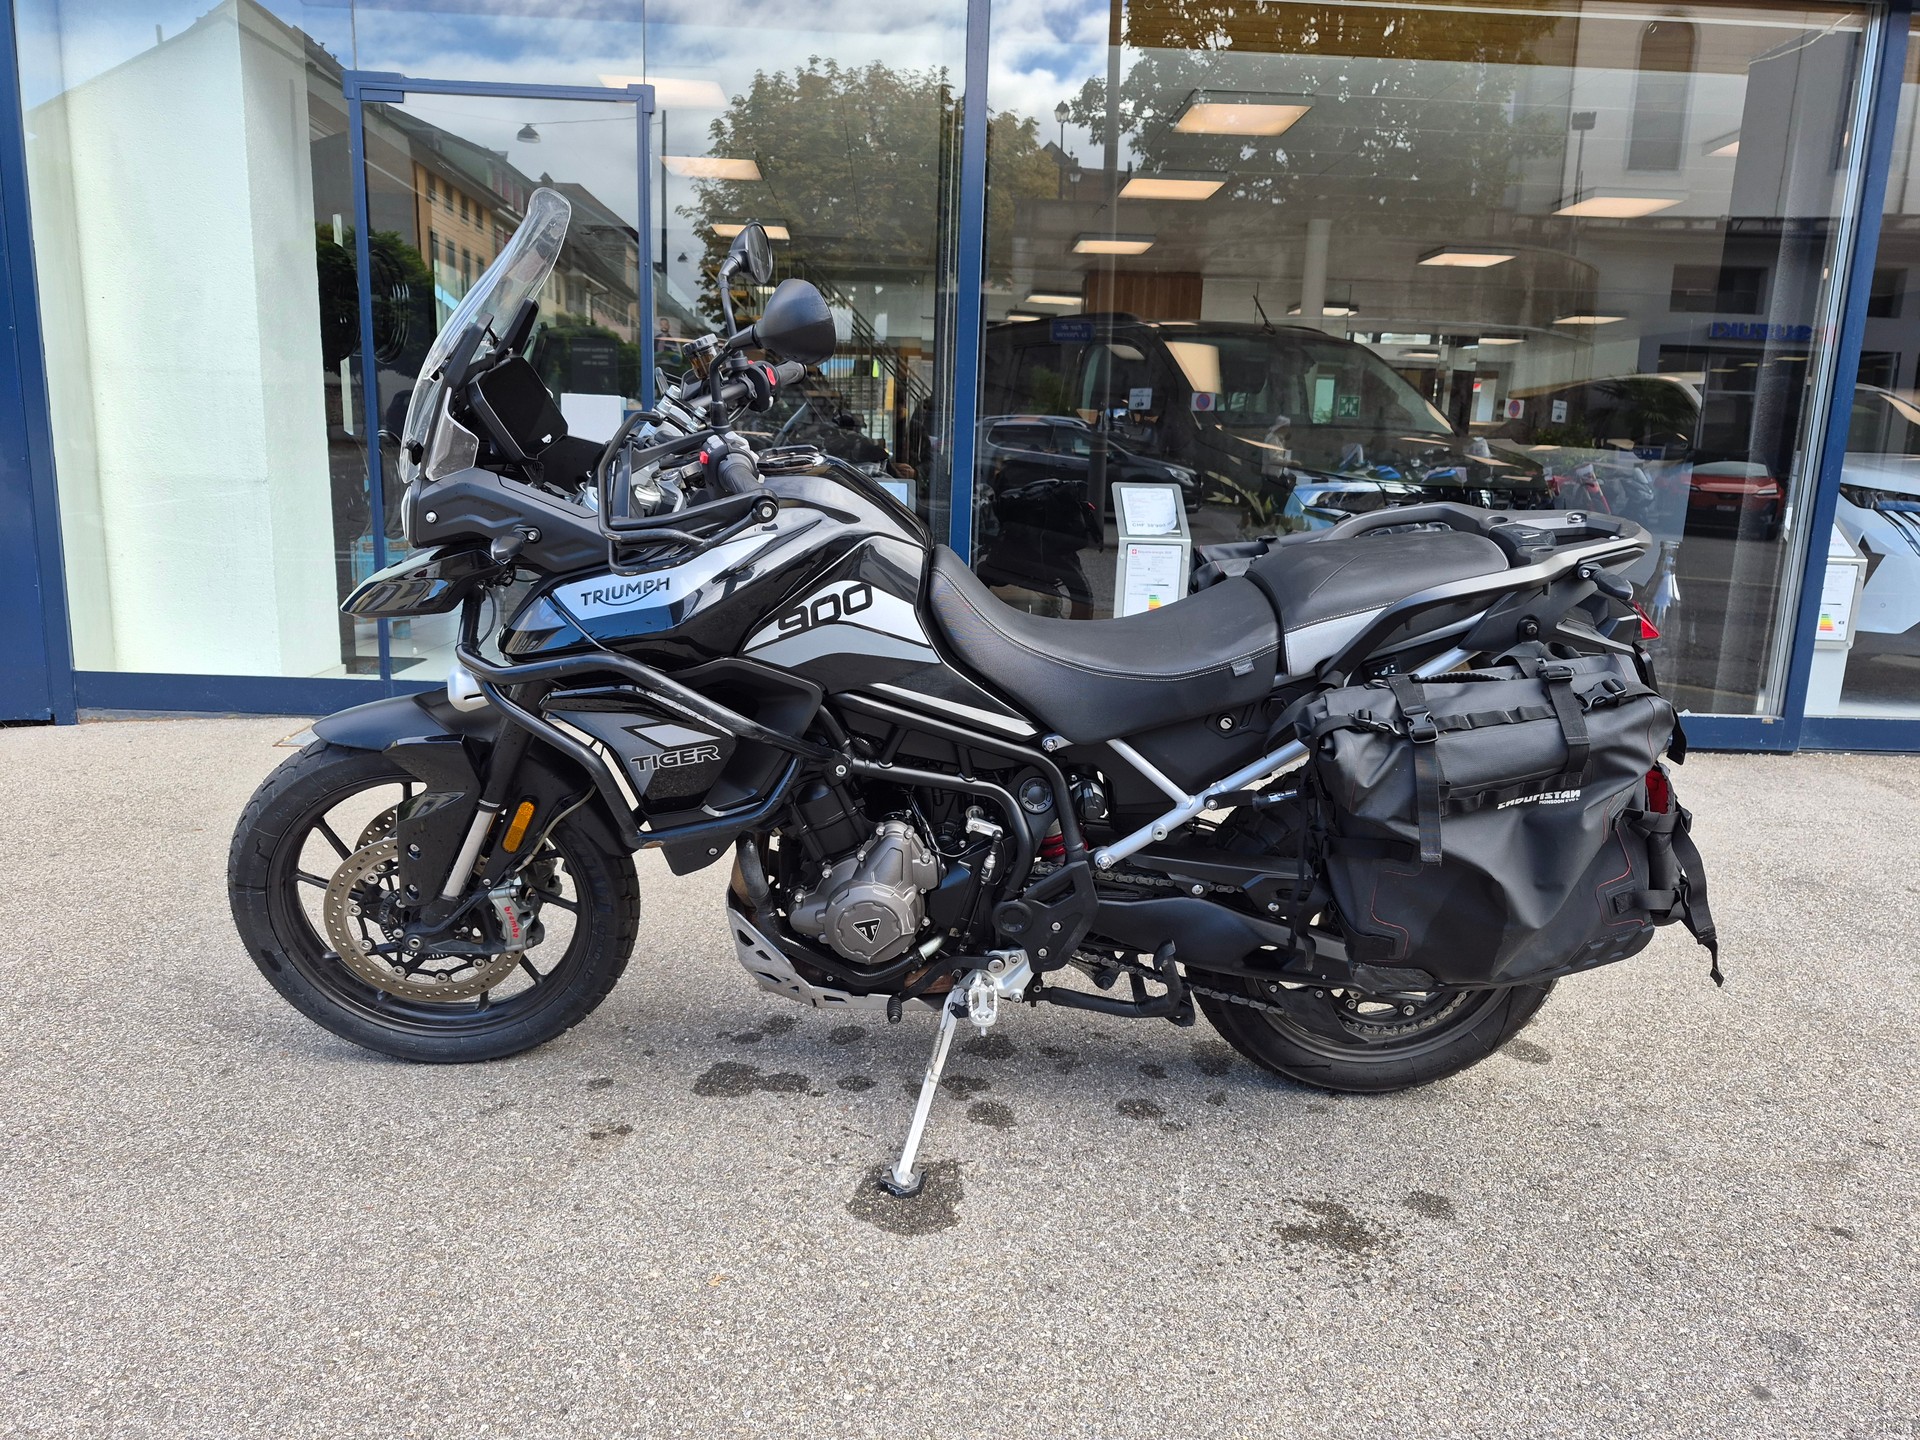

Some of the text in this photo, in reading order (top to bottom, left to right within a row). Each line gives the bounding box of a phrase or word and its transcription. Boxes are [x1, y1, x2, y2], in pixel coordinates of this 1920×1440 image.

[580, 577, 670, 605] TRIUMPH
[777, 583, 874, 633] 900
[631, 745, 721, 772] TIGER
[1497, 789, 1581, 810] ENDURISTAN
[504, 905, 519, 938] brembo
